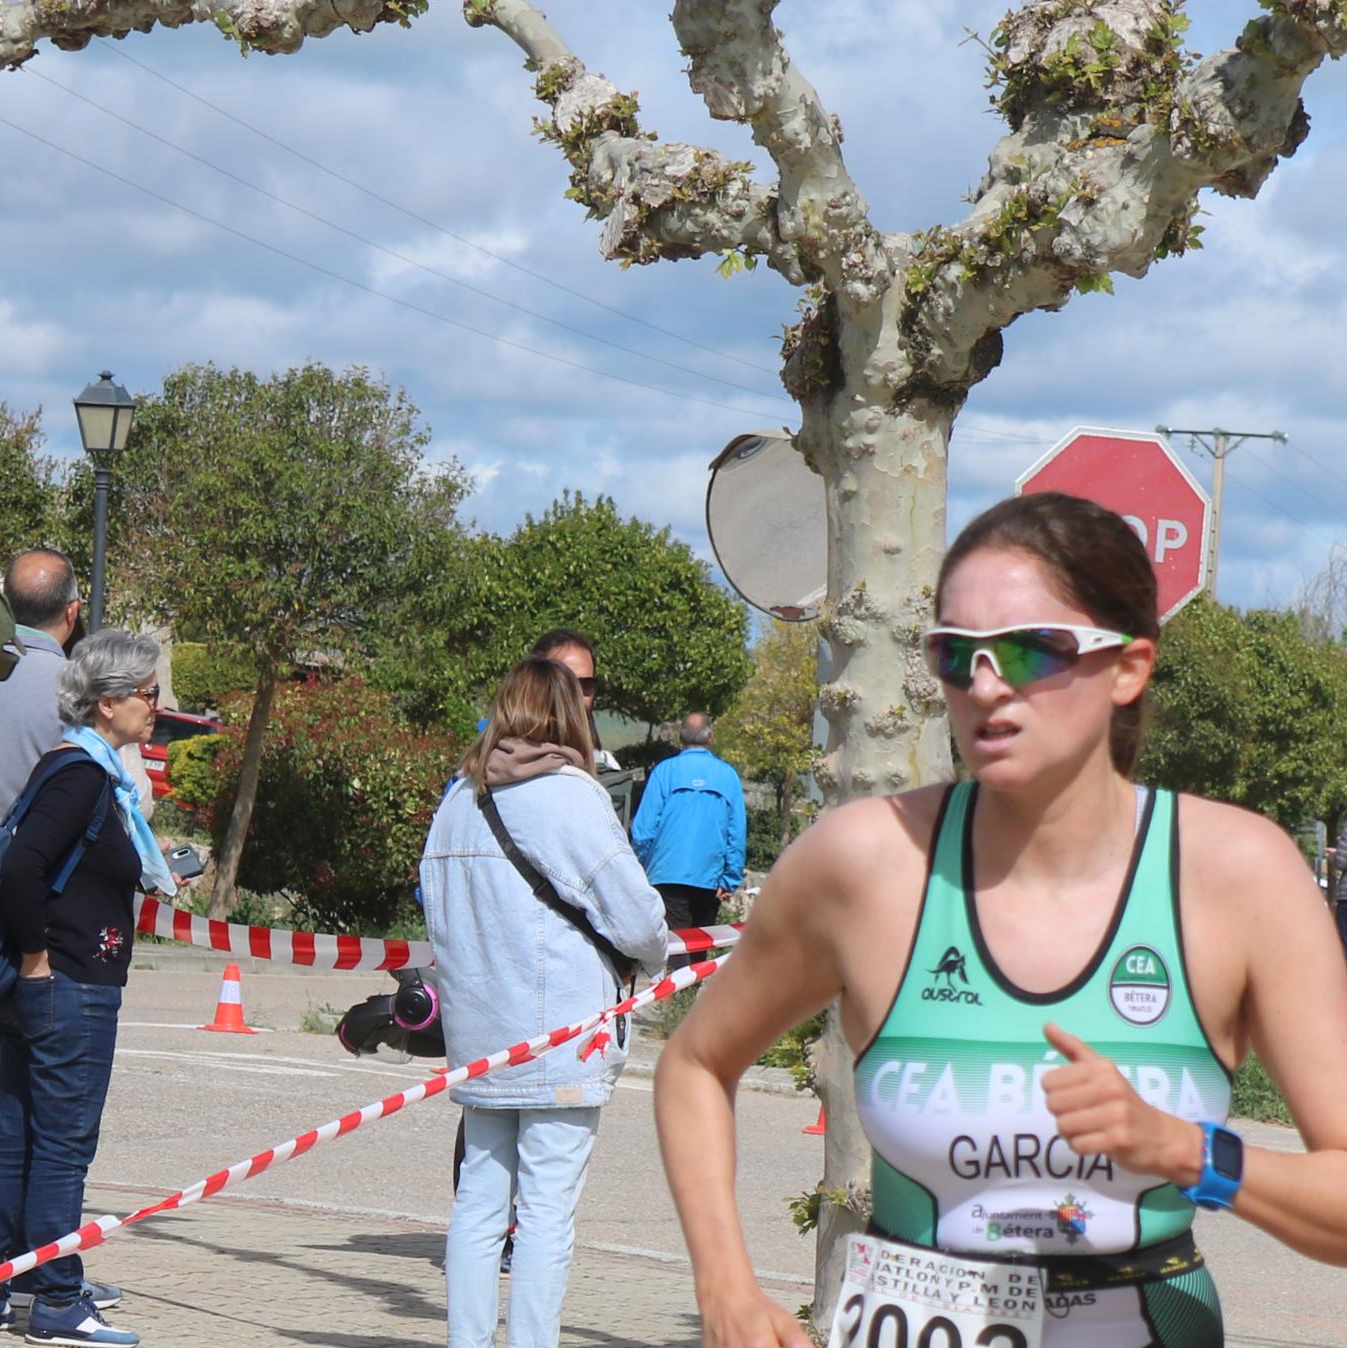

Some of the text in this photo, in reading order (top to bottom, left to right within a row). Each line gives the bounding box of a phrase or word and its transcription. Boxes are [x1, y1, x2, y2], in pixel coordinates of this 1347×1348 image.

[1126, 955, 1155, 975] CEA
[870, 1061, 963, 1114] CEA
[986, 1221, 1055, 1242] Bétera
[880, 1250, 985, 1281] DERACION
[1008, 1274, 1039, 1286] DE
[1009, 1286, 1037, 1299] DE
[974, 1295, 1036, 1311] LEON
